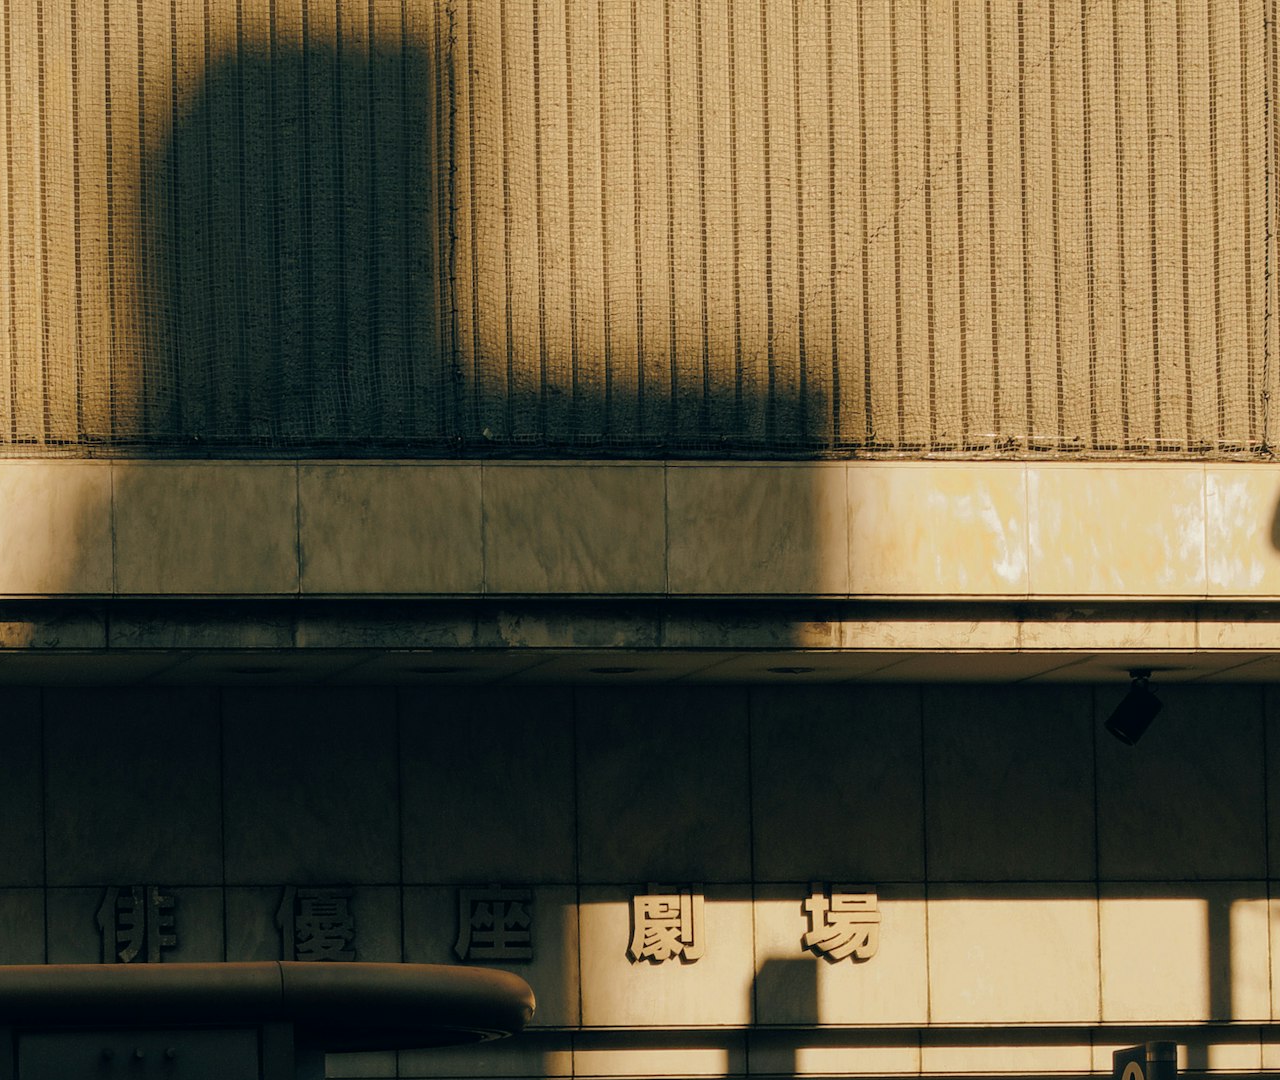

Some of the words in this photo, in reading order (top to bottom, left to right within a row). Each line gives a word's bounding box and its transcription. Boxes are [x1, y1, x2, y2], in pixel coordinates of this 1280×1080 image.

[96, 883, 882, 964] 俳優座劇場
